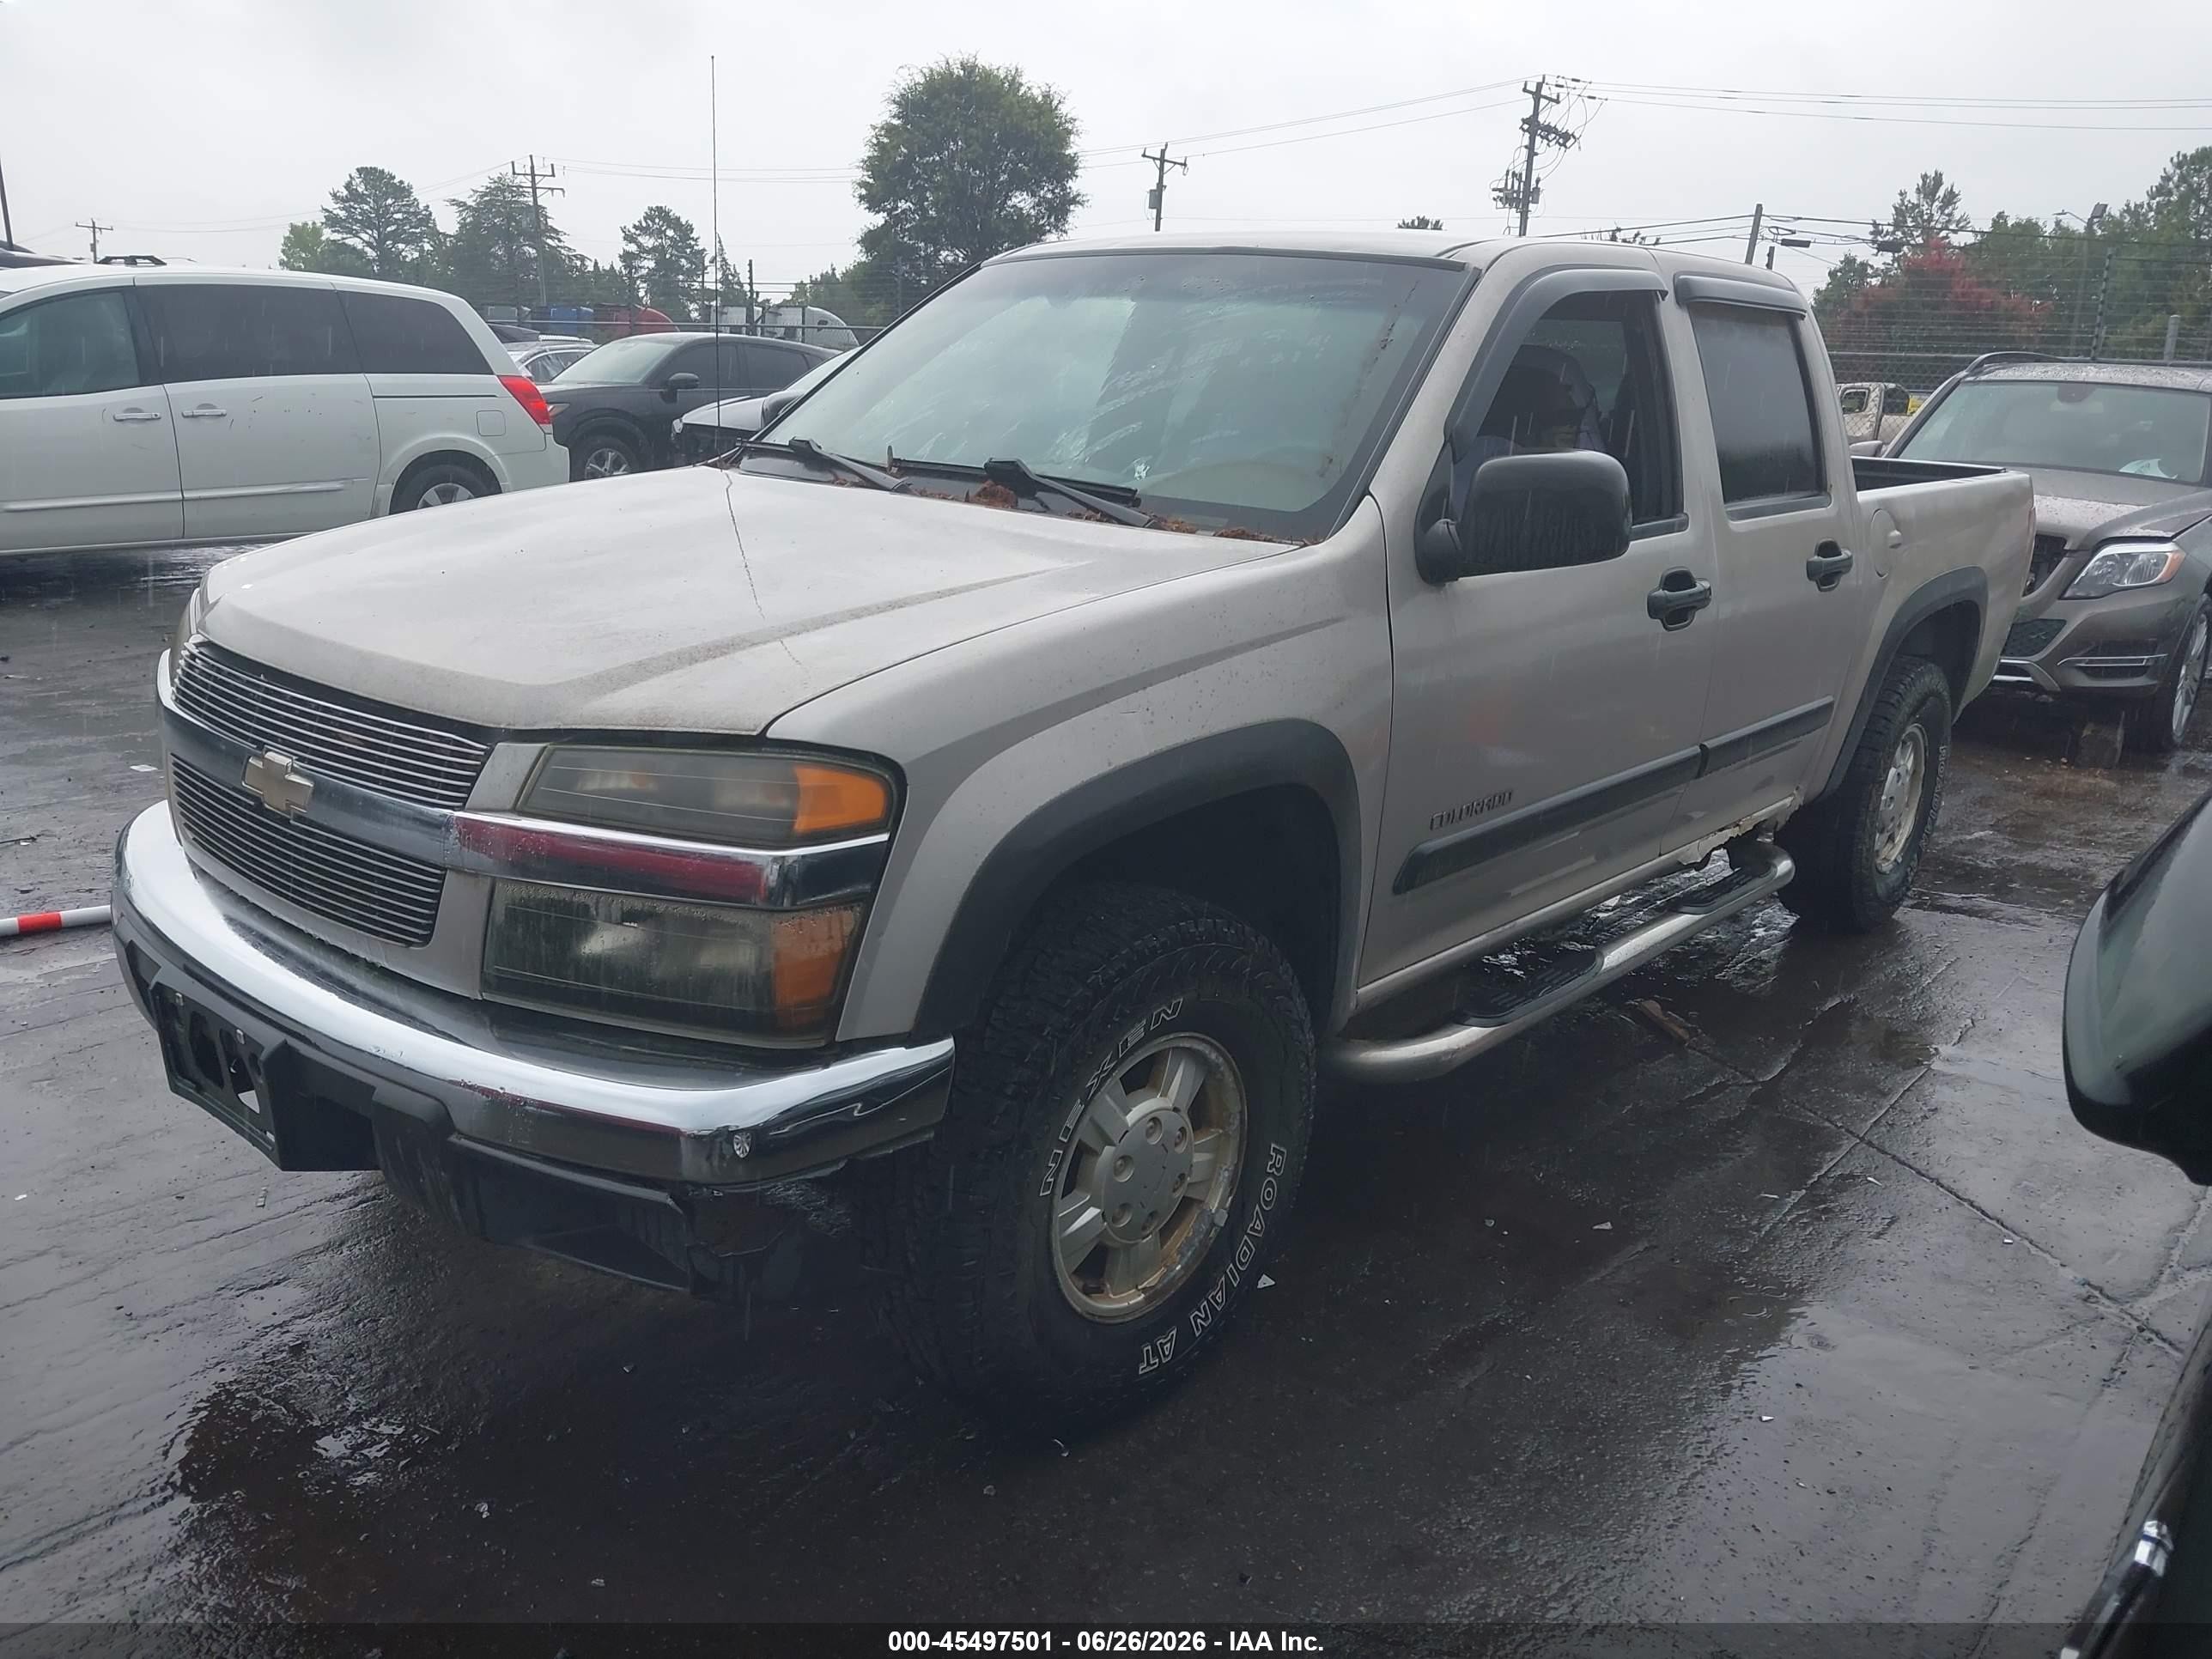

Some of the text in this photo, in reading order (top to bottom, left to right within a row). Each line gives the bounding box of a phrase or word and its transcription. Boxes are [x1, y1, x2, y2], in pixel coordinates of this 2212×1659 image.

[1429, 791, 1513, 830] COLORADO
[1039, 997, 1184, 1197] NEXEN
[1139, 1143, 1286, 1375] ROADIAN AT
